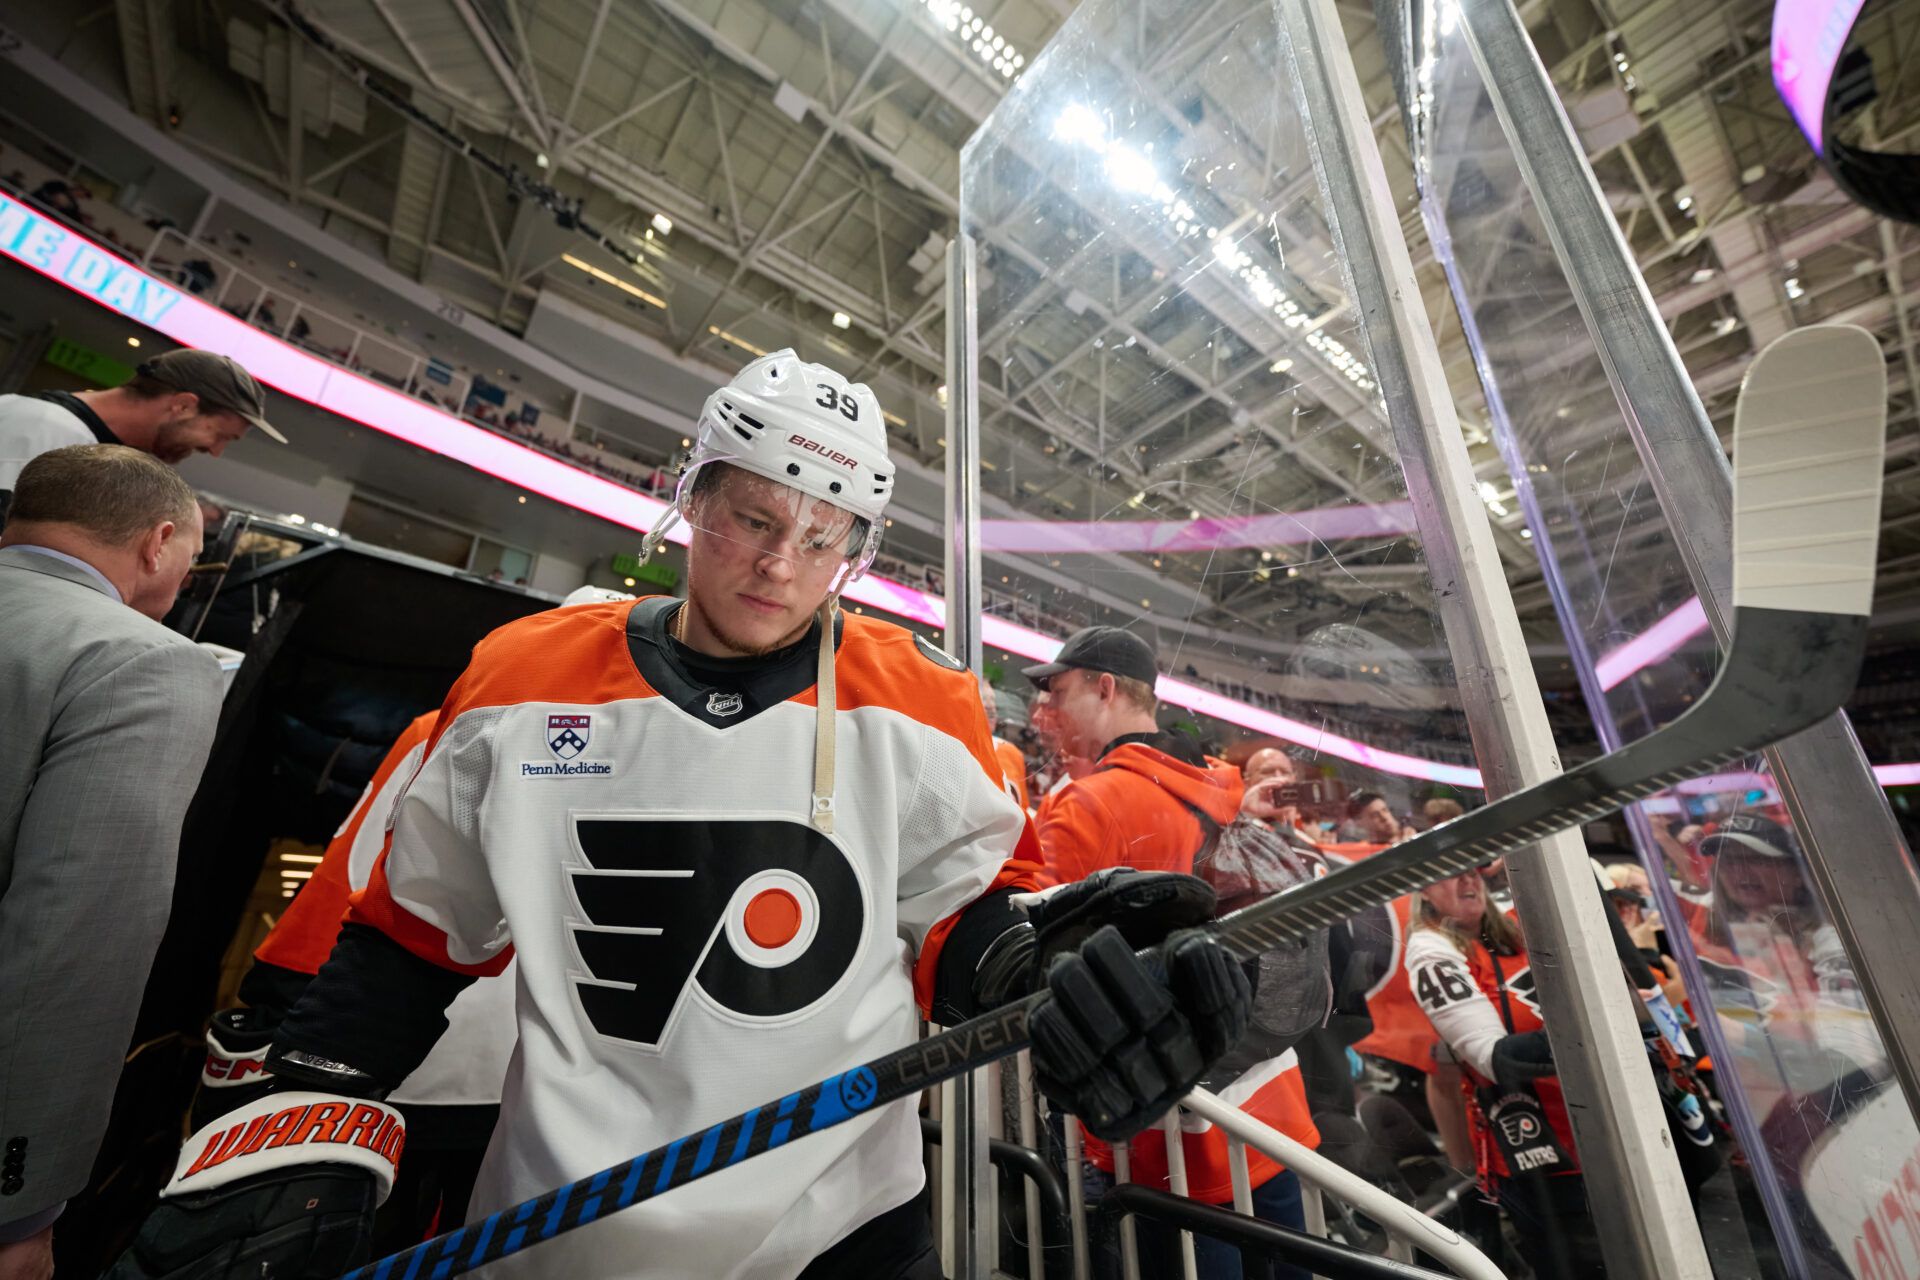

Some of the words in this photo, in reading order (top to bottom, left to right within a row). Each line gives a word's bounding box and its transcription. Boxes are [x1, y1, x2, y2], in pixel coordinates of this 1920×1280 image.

[63, 243, 181, 326] DAY
[816, 383, 859, 422] 39
[522, 763, 552, 776] Penn
[555, 761, 611, 775] Medicine
[1417, 960, 1473, 1010] 46
[178, 1101, 406, 1184] WARRIO
[1514, 1144, 1559, 1171] FLYERS
